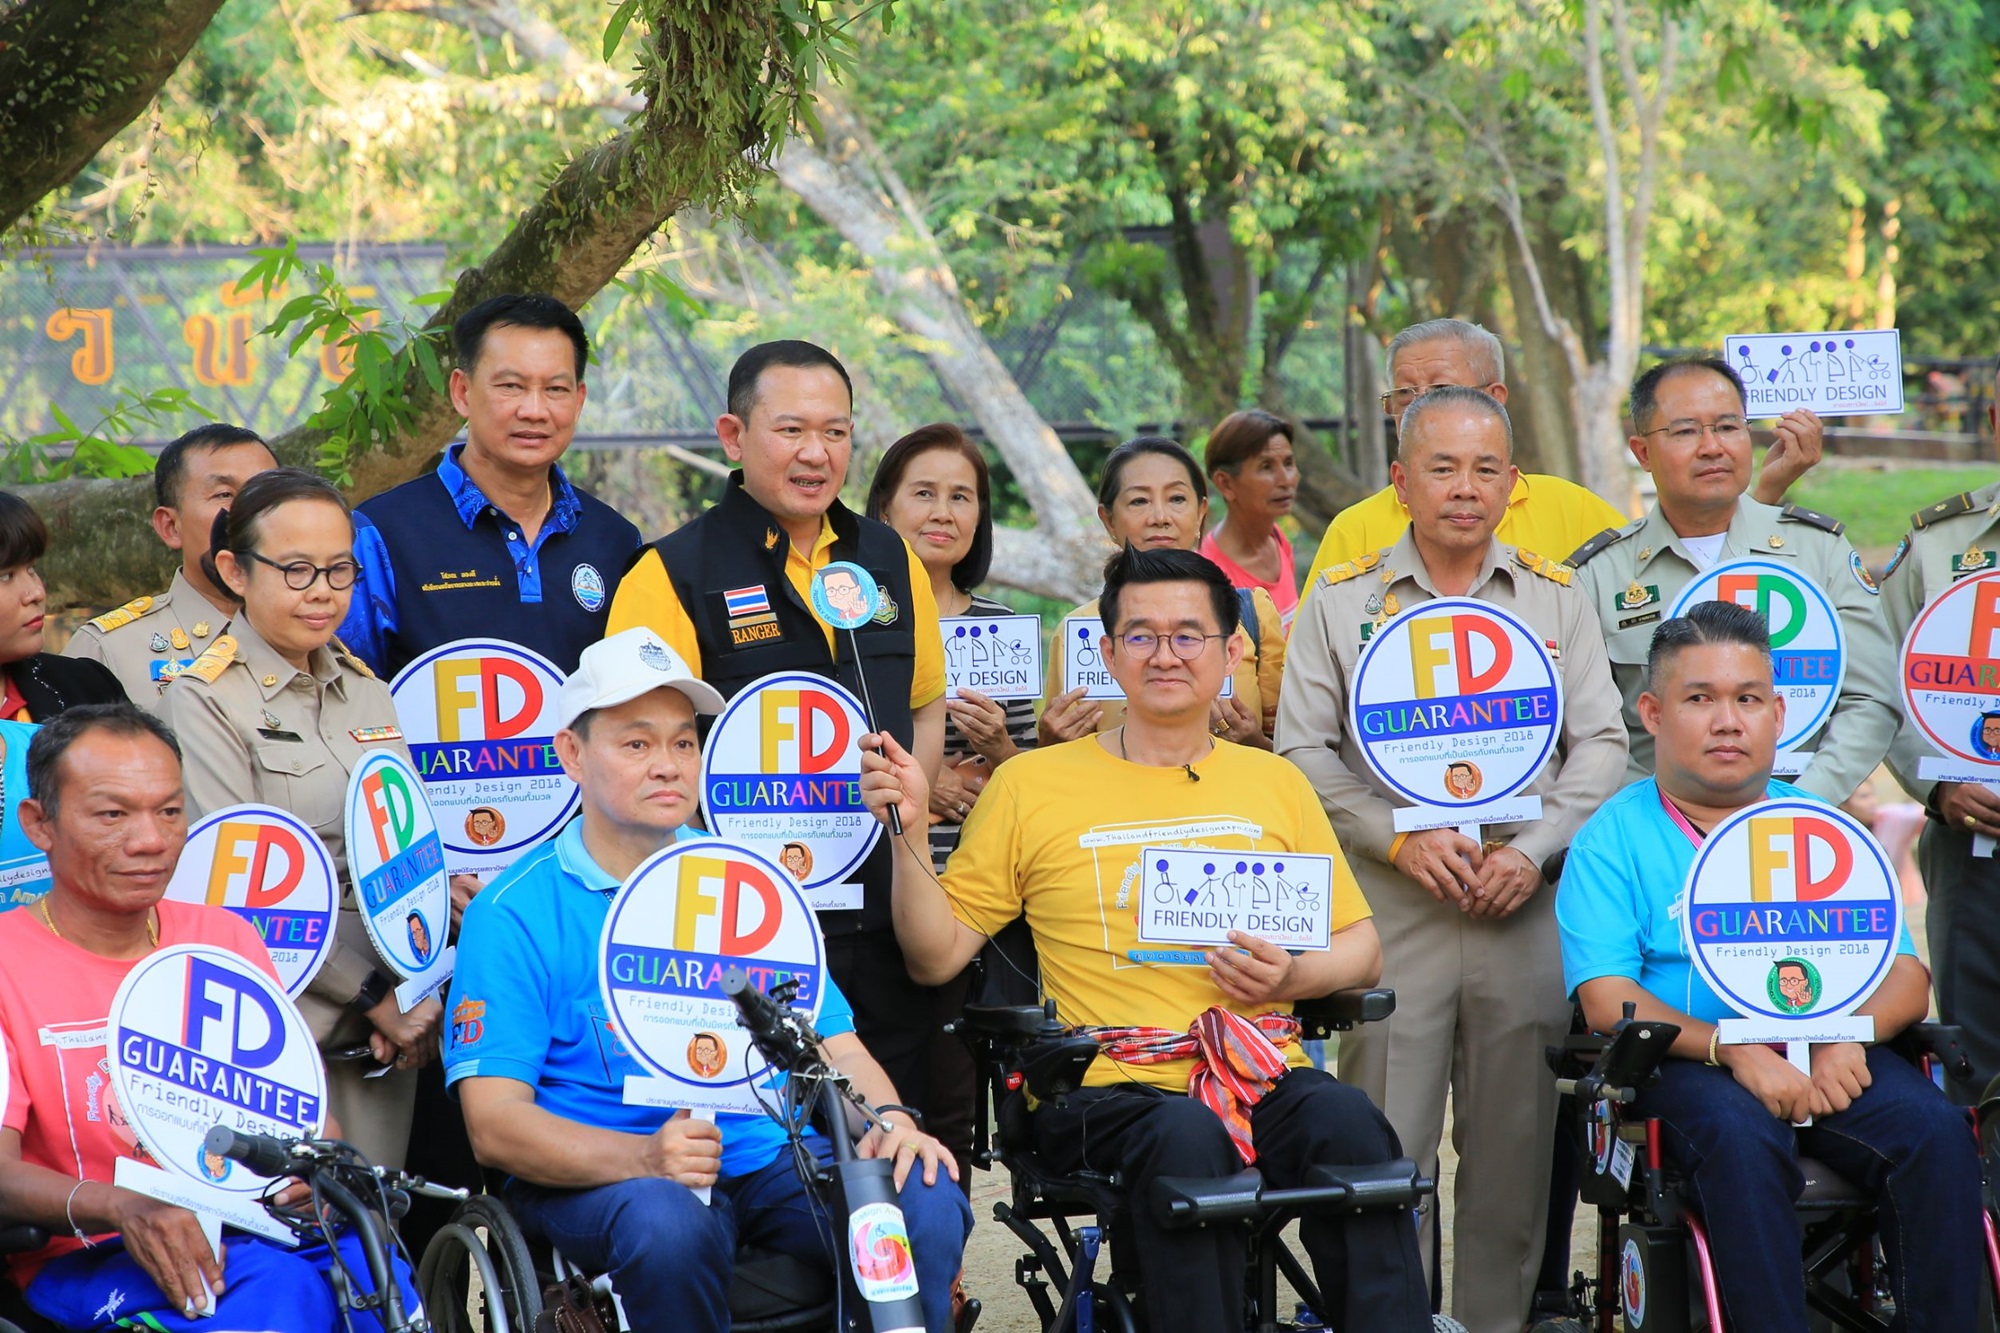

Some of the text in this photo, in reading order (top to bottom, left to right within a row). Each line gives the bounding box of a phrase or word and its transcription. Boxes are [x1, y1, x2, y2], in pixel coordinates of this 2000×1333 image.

[1826, 385, 1887, 401] DESIGN
[731, 622, 781, 645] RANGER
[1408, 613, 1513, 700] FD
[969, 670, 1027, 686] DESIGN
[433, 657, 544, 743] FD
[1790, 688, 1816, 698] 2018
[1925, 693, 1986, 709] Friendly
[1362, 695, 1551, 736] GUARANTEE
[760, 690, 850, 775] FD
[1384, 730, 1534, 754] Friendly Design 2018
[428, 778, 562, 796] endly Design 2018
[711, 780, 862, 807] GUARANTE
[361, 766, 414, 863] FD
[728, 815, 862, 830] Friendly Design 2018
[204, 821, 305, 909] FD
[1748, 816, 1854, 902] FD
[364, 839, 443, 909] GUARANTEE
[672, 855, 783, 957] FD
[1154, 909, 1313, 932] FRIENDLY DESIGN
[1695, 907, 1888, 937] GUARANTEE
[271, 951, 298, 963] 2018
[1716, 944, 1870, 959] Friendly Design 2018
[181, 954, 286, 1069] FD
[629, 995, 739, 1017] Friendly Desi
[122, 1035, 315, 1126] GUARANTEE
[130, 1073, 223, 1124] Friendly
